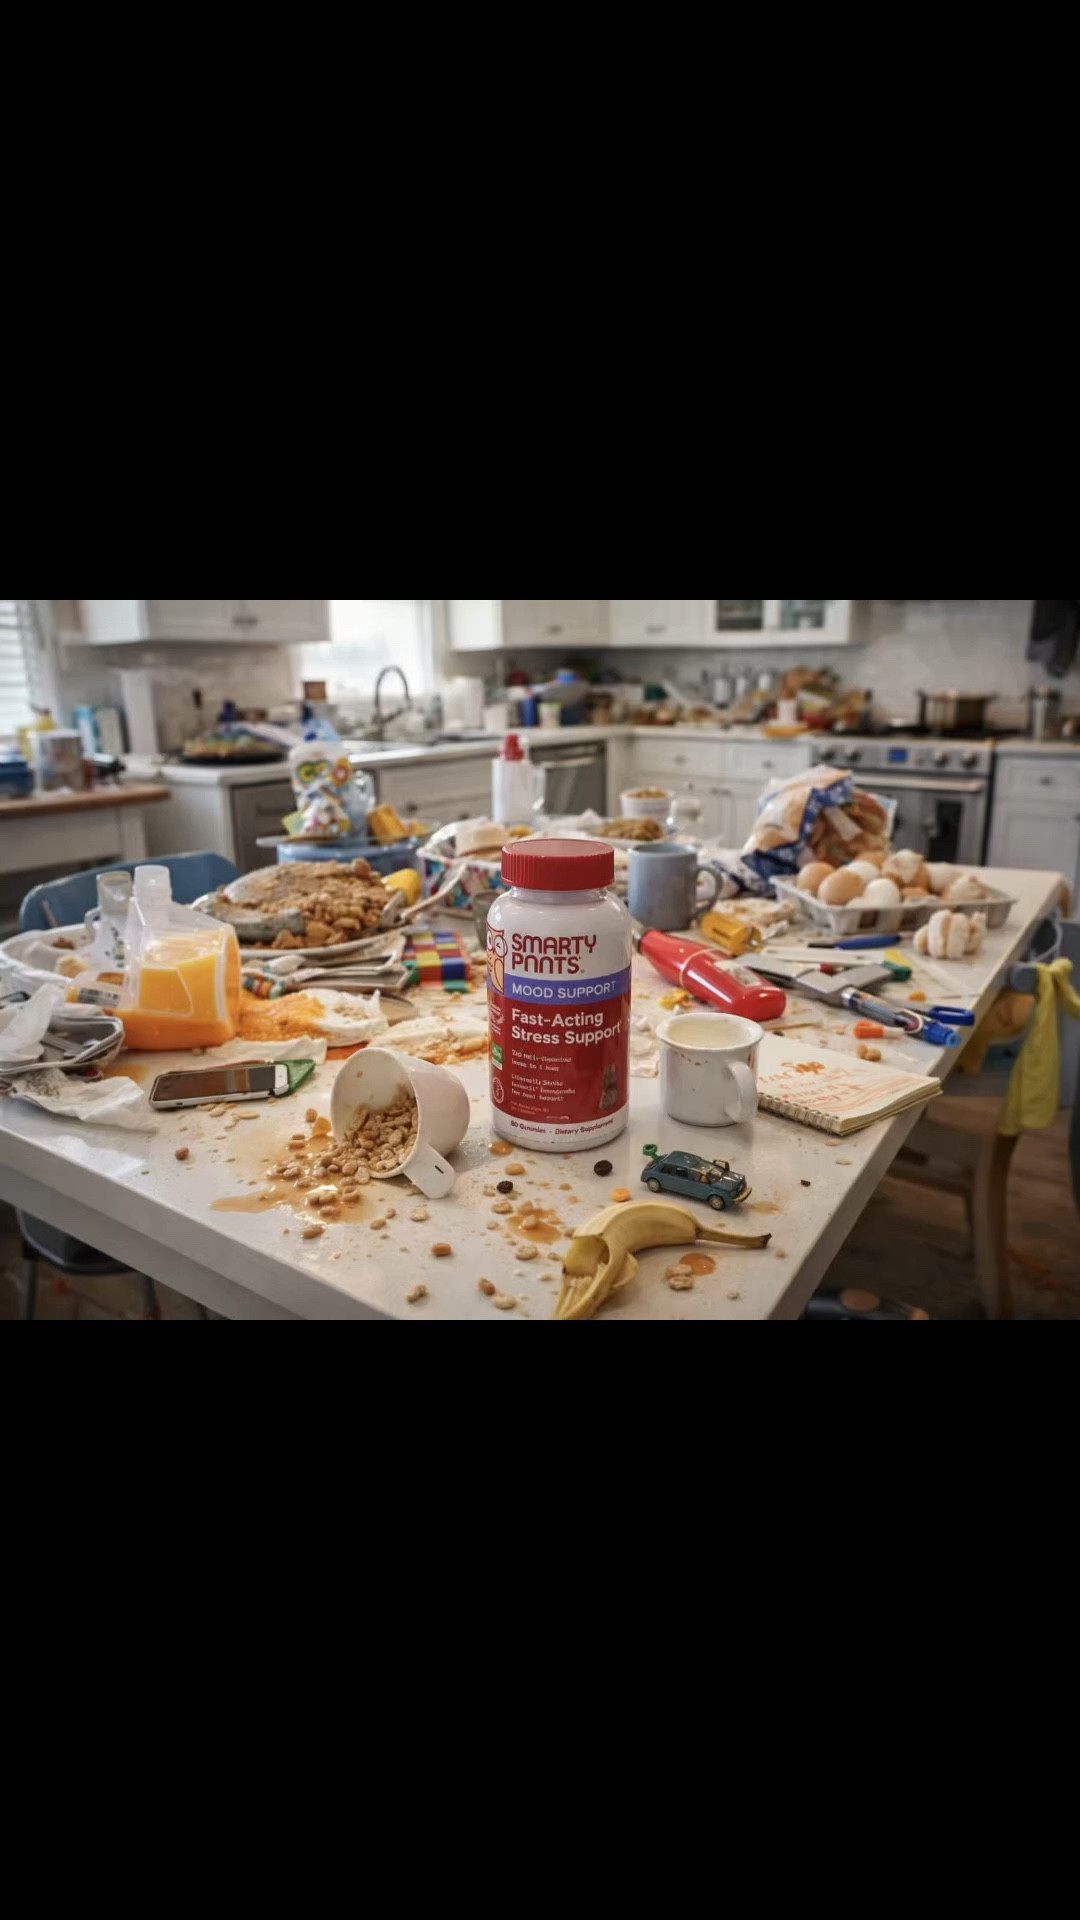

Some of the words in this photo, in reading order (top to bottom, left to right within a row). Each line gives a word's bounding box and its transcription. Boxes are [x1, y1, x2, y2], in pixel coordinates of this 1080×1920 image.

[511, 932, 597, 955] SMARTY
[512, 982, 554, 998] MOOD
[557, 981, 616, 999] SUPPORT
[511, 1007, 604, 1028] Fast-Acting
[511, 1025, 560, 1045] Stress
[564, 1021, 621, 1047] Support
